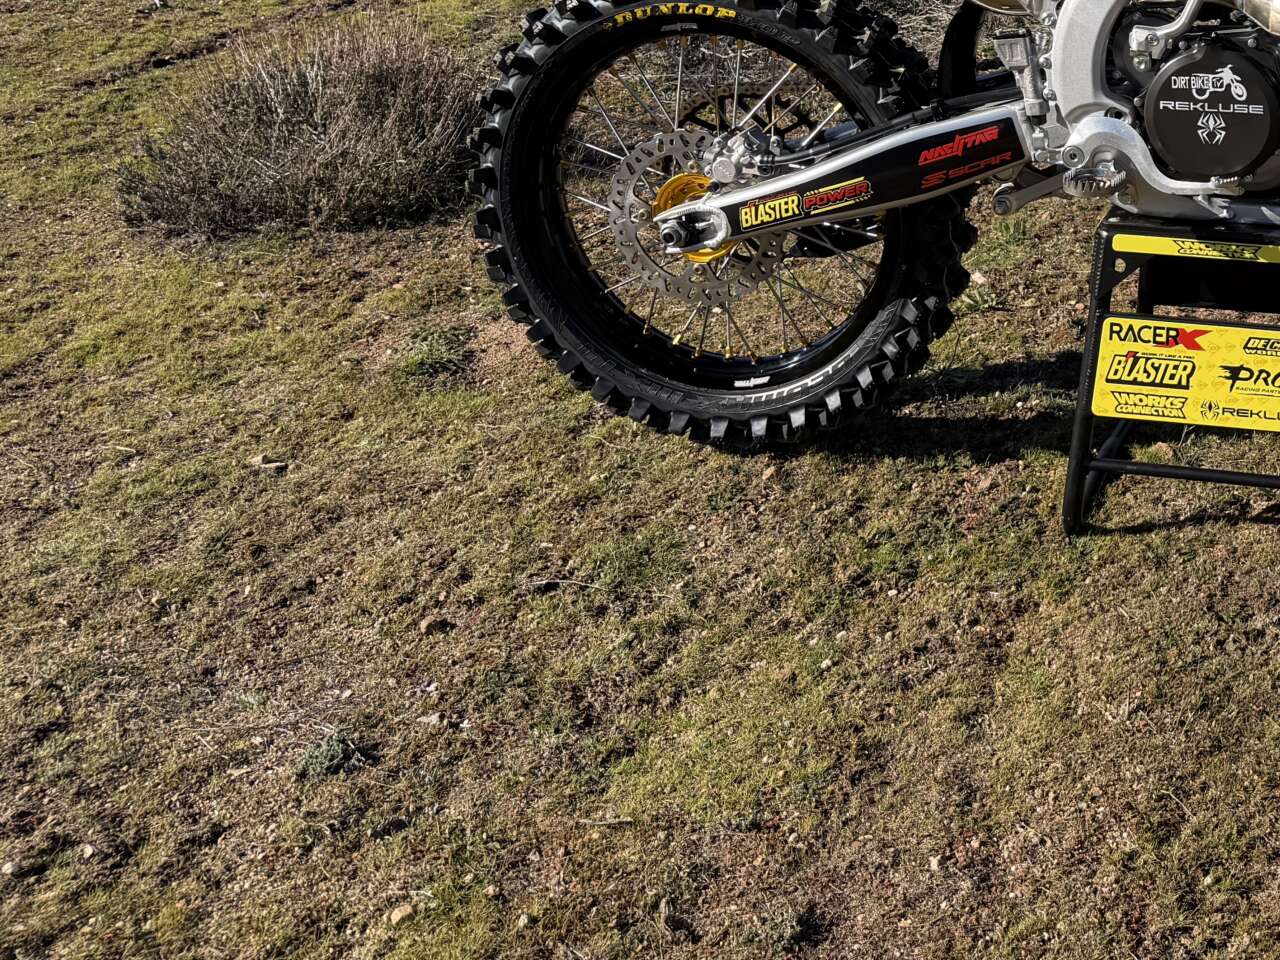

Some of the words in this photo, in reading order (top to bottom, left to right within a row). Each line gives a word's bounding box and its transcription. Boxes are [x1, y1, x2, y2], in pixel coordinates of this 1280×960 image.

[613, 2, 737, 27] DUNLOP
[1171, 76, 1190, 89] DIRT
[1190, 76, 1210, 89] BIKE
[1211, 77, 1224, 89] TV
[1159, 100, 1264, 115] REKLUSE
[741, 195, 800, 228] BLASTER
[803, 181, 870, 210] POWER
[1173, 240, 1261, 254] WORKS
[1107, 353, 1194, 386] BLASTER
[1112, 391, 1187, 409] WORKS
[1115, 403, 1186, 419] CONNECTION
